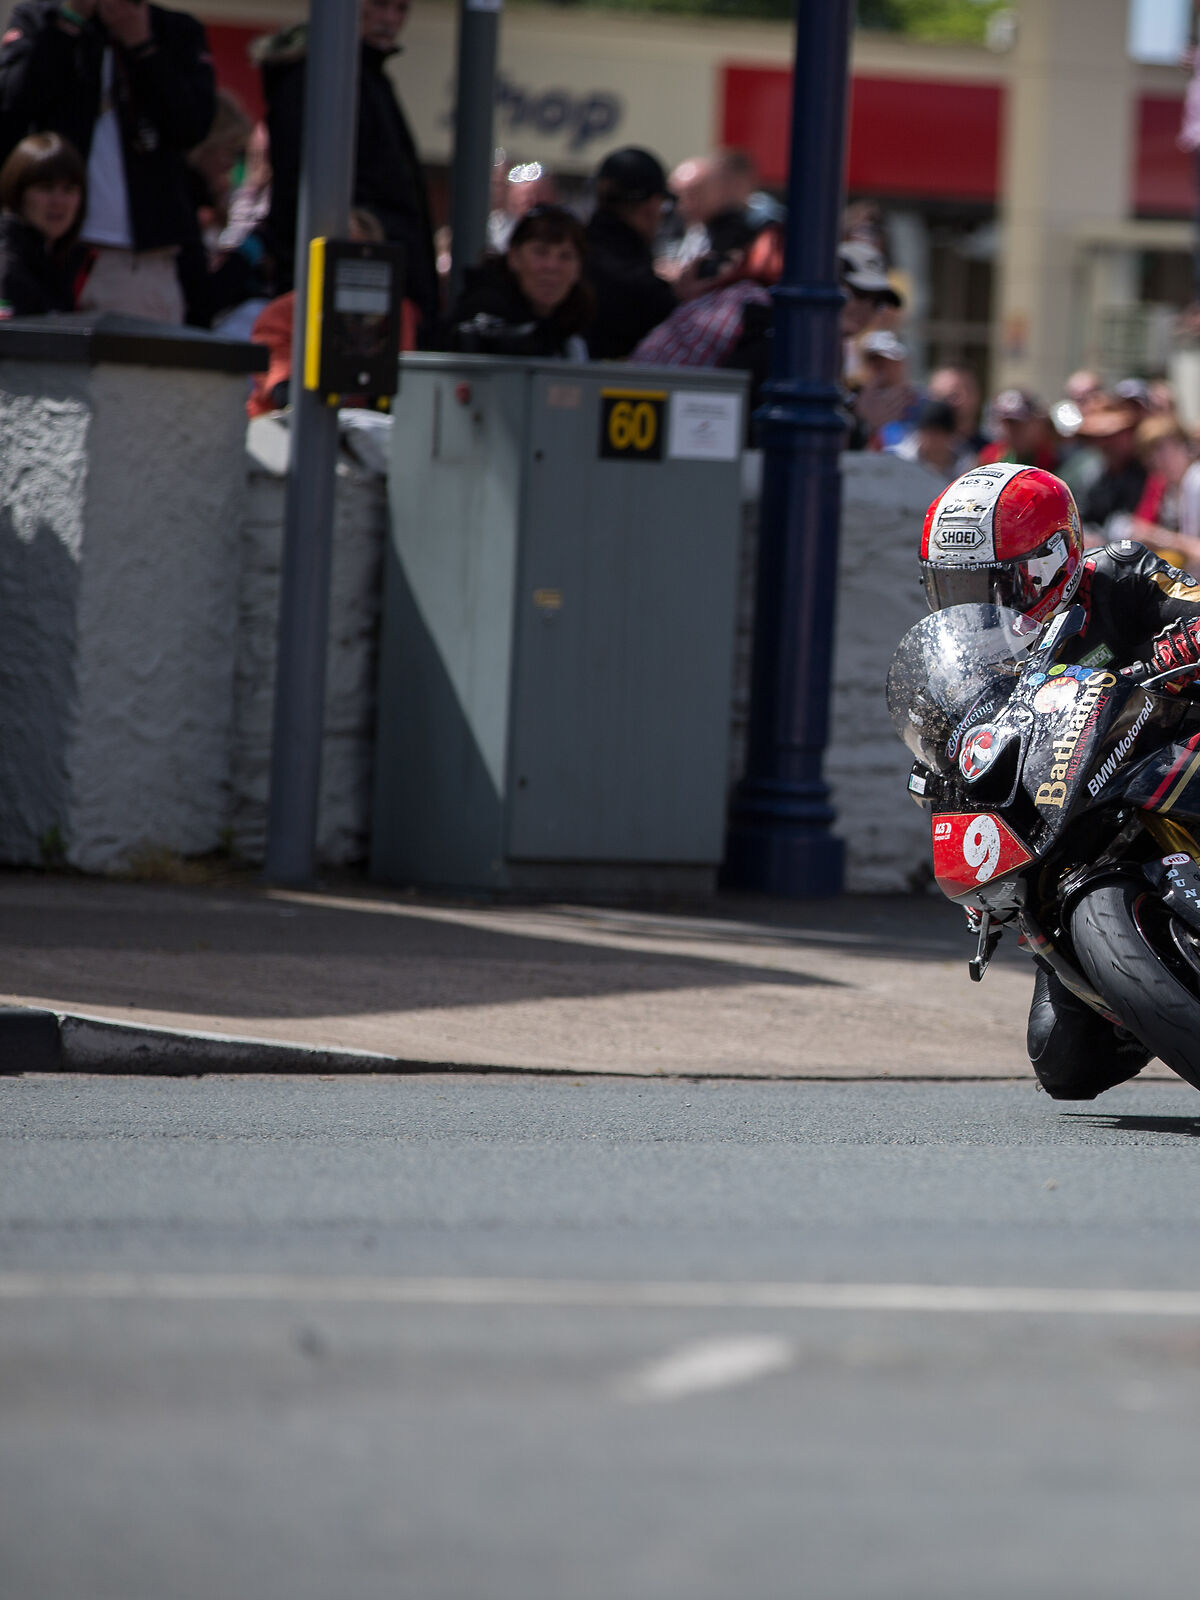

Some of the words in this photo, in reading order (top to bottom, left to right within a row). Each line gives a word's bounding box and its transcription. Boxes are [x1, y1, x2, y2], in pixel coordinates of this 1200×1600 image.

[437, 72, 622, 150] hop
[609, 401, 656, 451] 60
[941, 531, 977, 544] SHOEI
[1087, 754, 1118, 797] BMW
[1113, 696, 1154, 762] Motorrad
[963, 814, 1001, 882] 9
